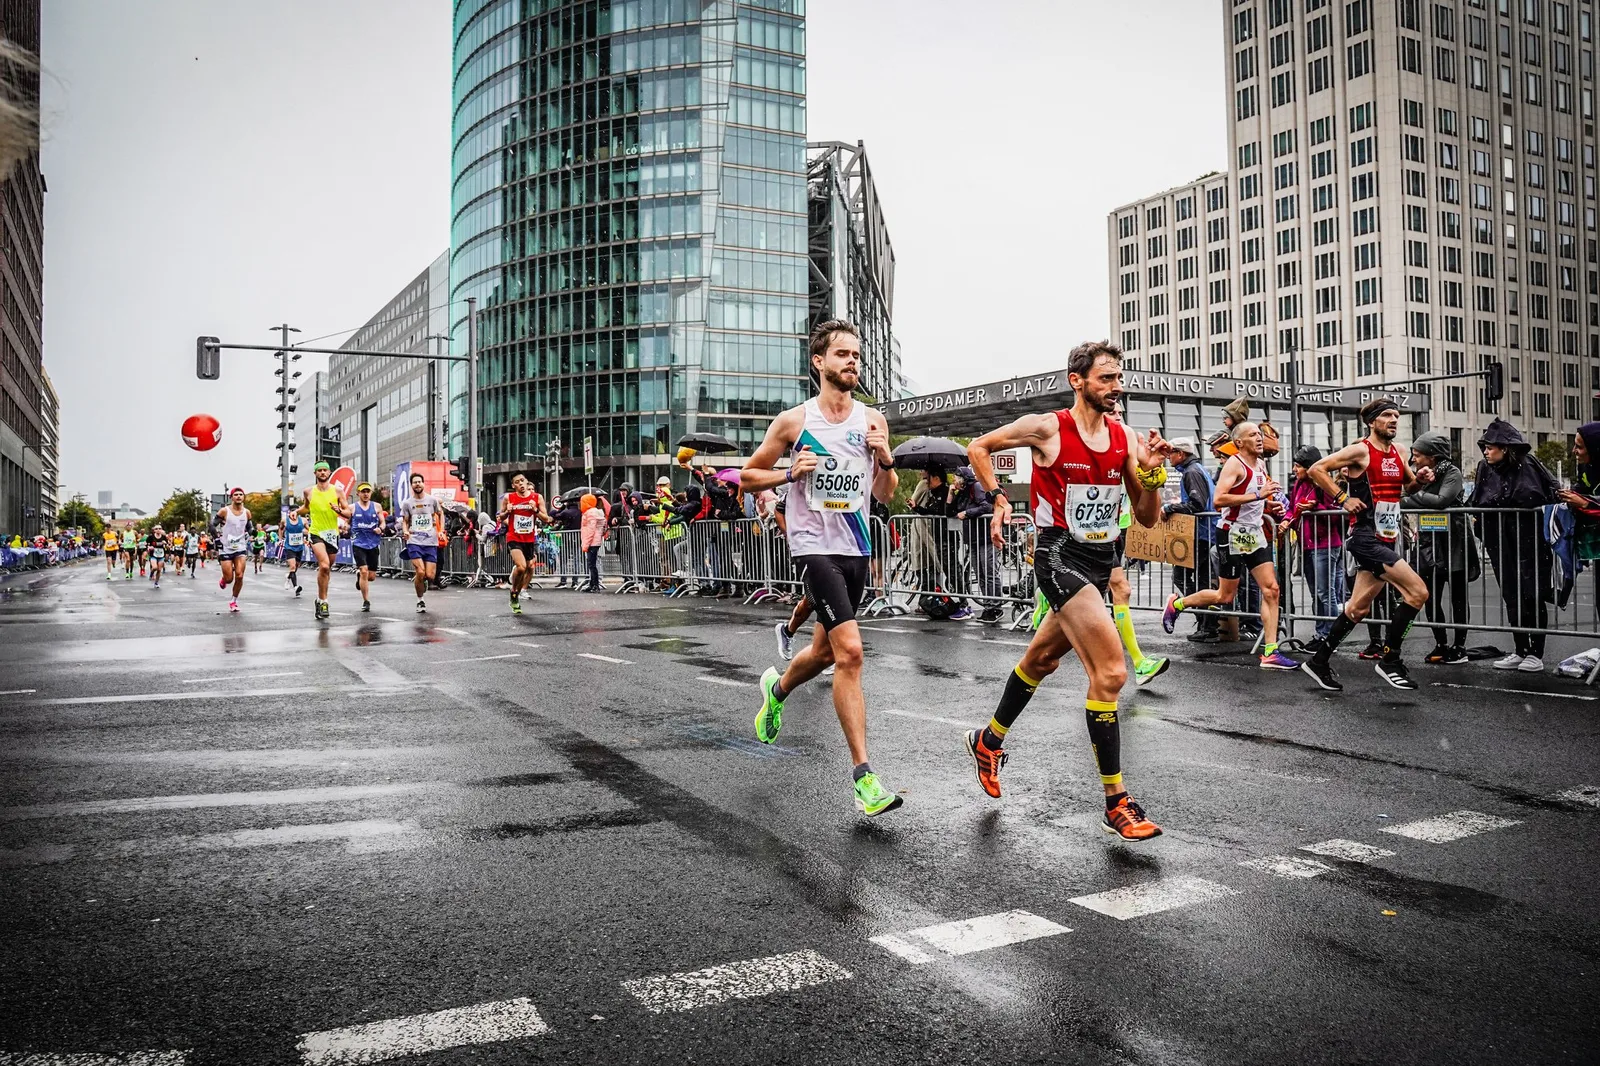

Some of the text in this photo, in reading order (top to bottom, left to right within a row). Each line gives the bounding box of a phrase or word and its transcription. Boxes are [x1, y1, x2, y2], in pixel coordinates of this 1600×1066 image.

[899, 375, 1057, 415] POTSDAMER PLATZ
[1119, 373, 1215, 393] BAHNHOF
[1235, 382, 1343, 403] POTSDAMER
[999, 457, 1014, 468] DB
[815, 473, 860, 492] 55086
[826, 491, 848, 499] Nicolas
[1075, 502, 1117, 521] 67582
[1165, 520, 1185, 533] HERE
[1131, 540, 1161, 558] SPEED
